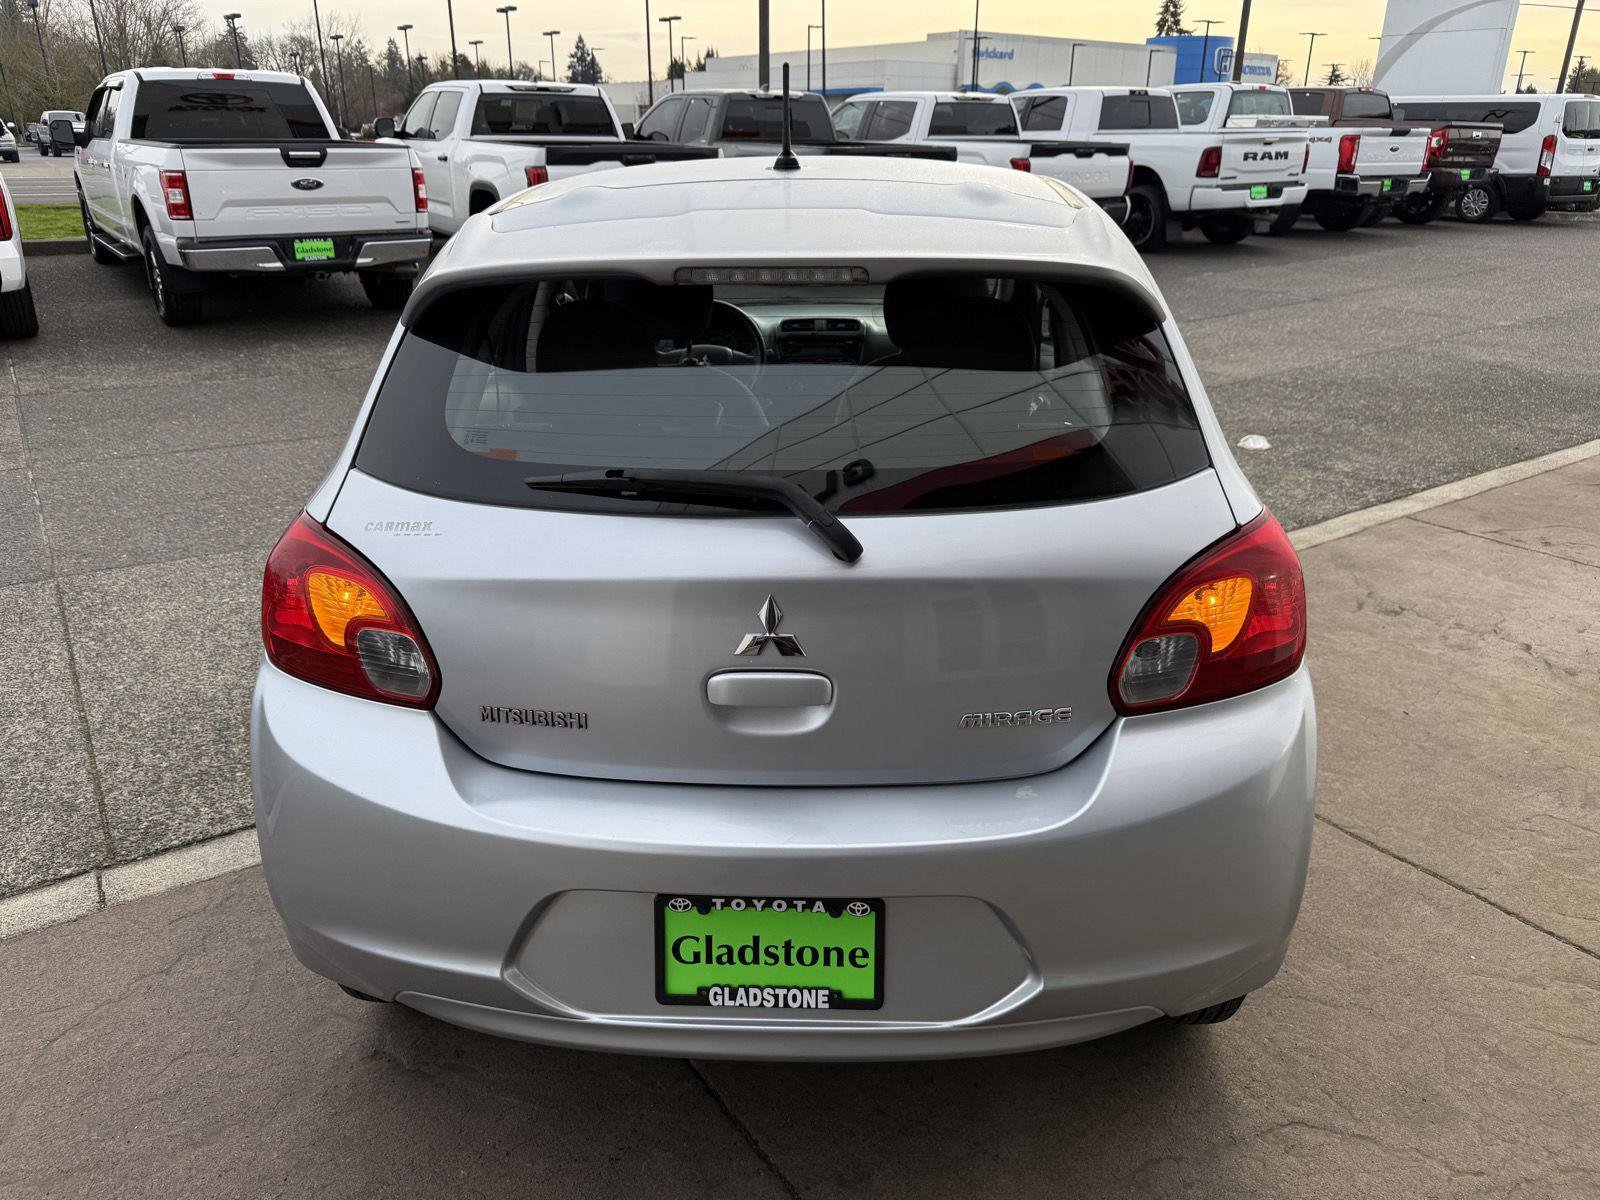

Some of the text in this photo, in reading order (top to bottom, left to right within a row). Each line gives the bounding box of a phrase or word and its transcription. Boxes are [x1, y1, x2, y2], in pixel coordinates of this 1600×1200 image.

[1243, 151, 1289, 161] RAM
[480, 706, 588, 730] MITSUBISHI
[959, 706, 1072, 728] MIRAGE
[712, 898, 826, 913] TOYOTA
[671, 934, 870, 968] Gladstone
[708, 986, 830, 1009] GLADSTONE
